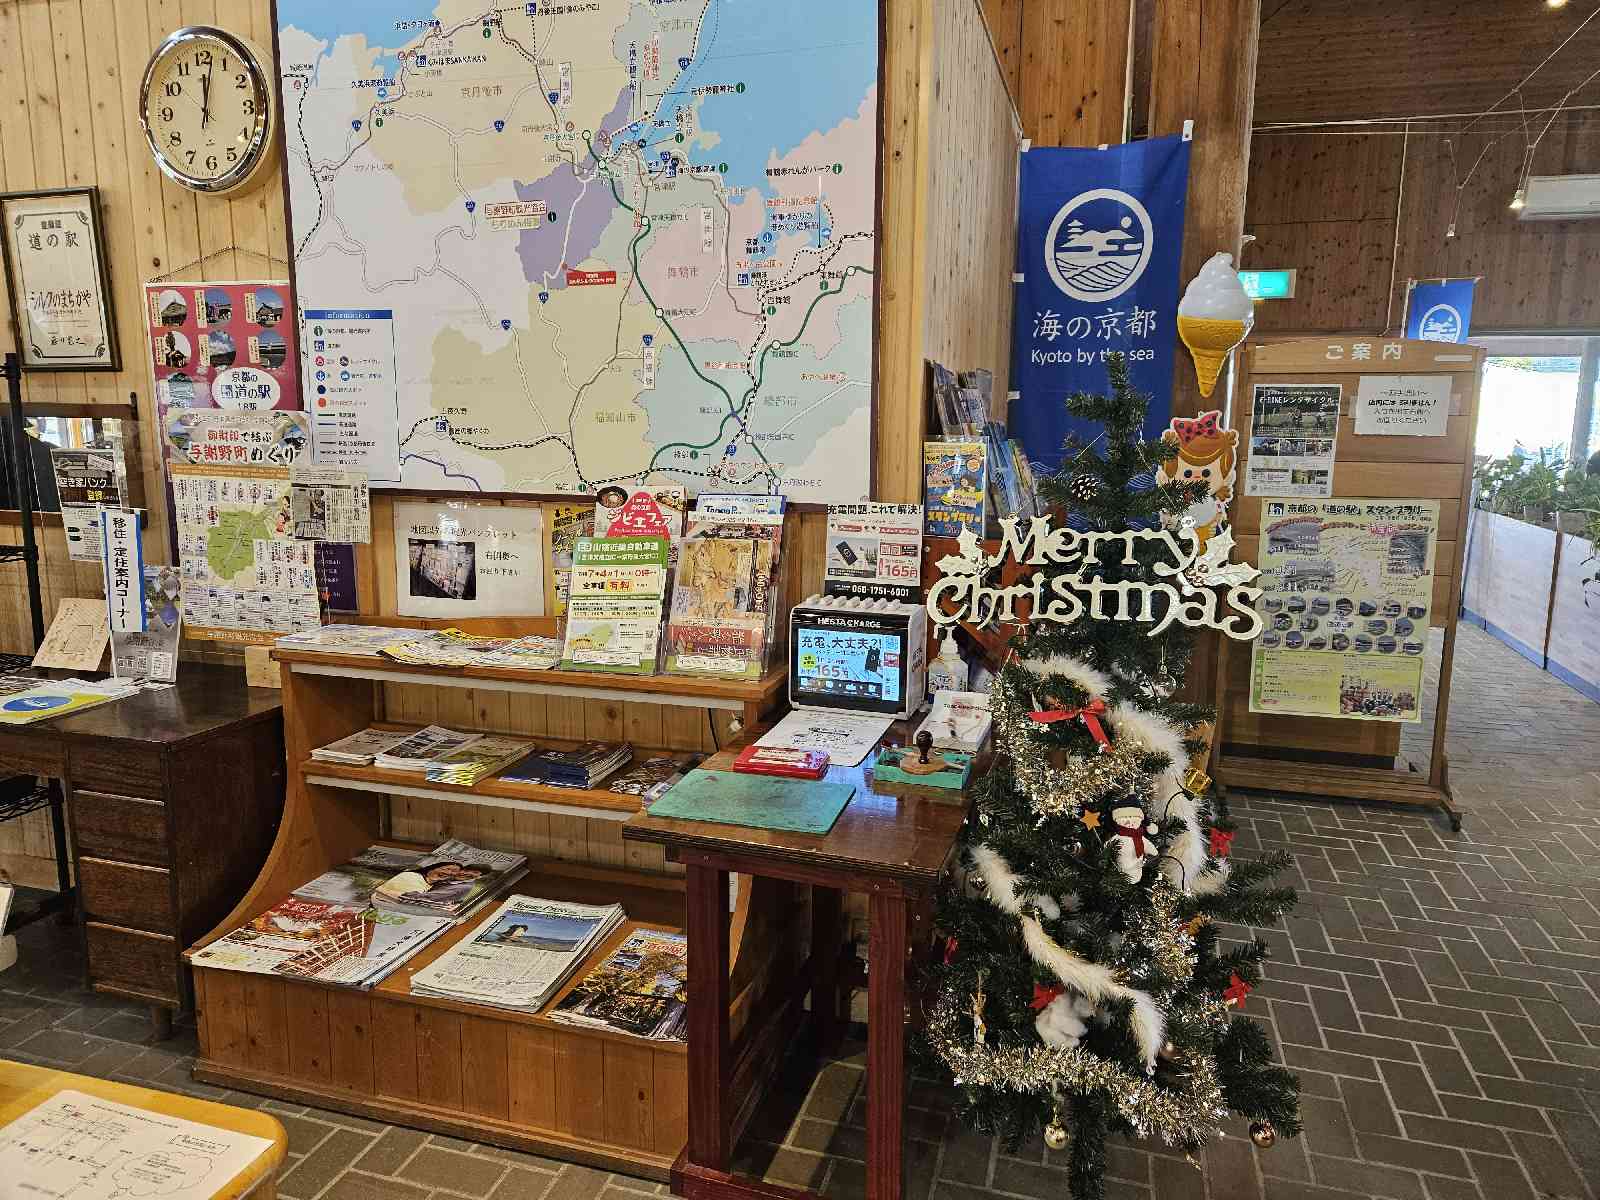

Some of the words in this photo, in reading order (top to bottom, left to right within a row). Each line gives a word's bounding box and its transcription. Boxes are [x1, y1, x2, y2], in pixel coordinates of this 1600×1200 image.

[195, 51, 211, 66] 12
[221, 58, 227, 71] 1
[177, 63, 191, 76] 11
[235, 74, 247, 88] 2
[165, 82, 182, 96] 10
[161, 107, 173, 121] 9
[243, 100, 254, 115] 3
[170, 132, 181, 146] 8
[186, 150, 196, 165] 7
[226, 147, 237, 161] 5
[206, 155, 217, 170] 6
[28, 231, 79, 250] 道の駅
[1032, 306, 1157, 341] 海の京都
[1031, 349, 1072, 366] Kyoto
[1077, 347, 1096, 366] by
[1129, 349, 1155, 361] sea
[1325, 342, 1403, 361] ご案内
[232, 371, 258, 382] 京都の
[234, 384, 272, 400] 道の駅
[190, 445, 295, 464] 与謝野町めぐり
[988, 514, 1201, 577] Merry
[112, 516, 131, 629] 移住・定住案内コーナー
[926, 571, 1264, 640] Christmas
